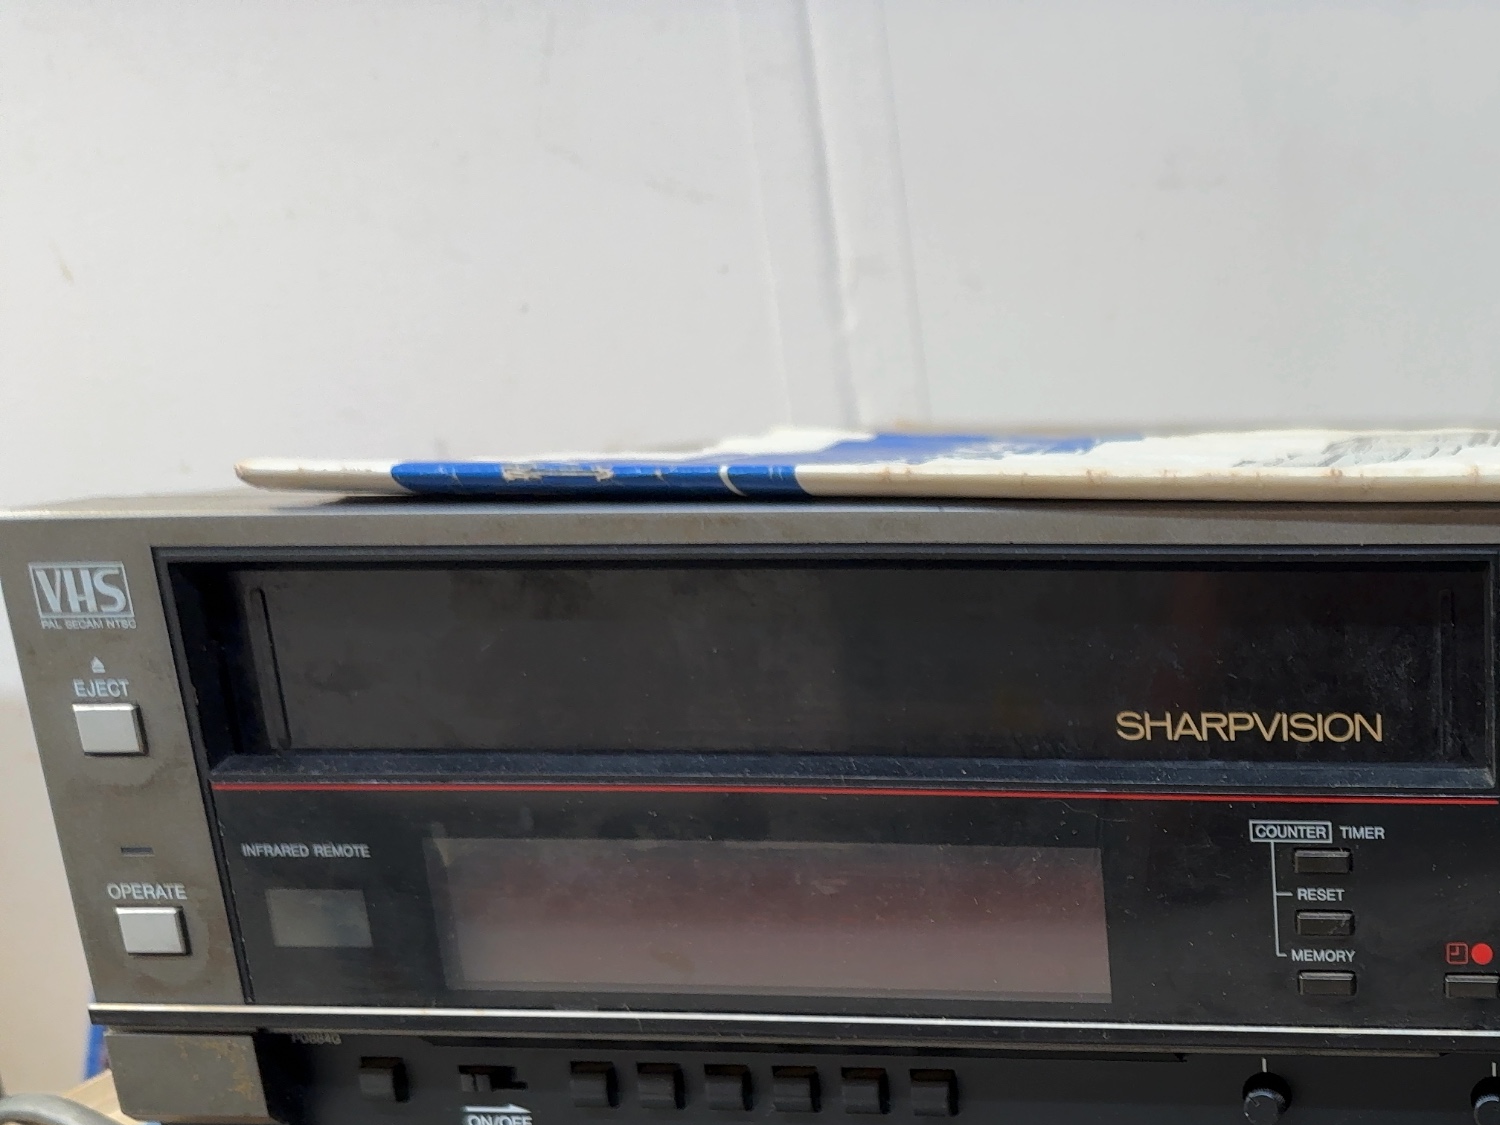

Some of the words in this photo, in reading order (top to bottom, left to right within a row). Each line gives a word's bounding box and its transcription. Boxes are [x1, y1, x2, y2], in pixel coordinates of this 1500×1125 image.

[35, 568, 126, 613] VHS
[41, 619, 62, 629] PAL
[65, 618, 103, 630] SECAM
[105, 619, 137, 630] NTSC
[73, 678, 129, 697] EJECT
[1116, 711, 1383, 742] SHARPVISION
[1255, 824, 1327, 840] COUNTER
[1339, 825, 1386, 840] TIMER
[240, 842, 310, 858] INFRARED
[313, 843, 371, 859] REMOTE
[107, 882, 187, 901] OPERATE
[1297, 887, 1345, 902] RESET
[1292, 948, 1356, 963] MEMORY
